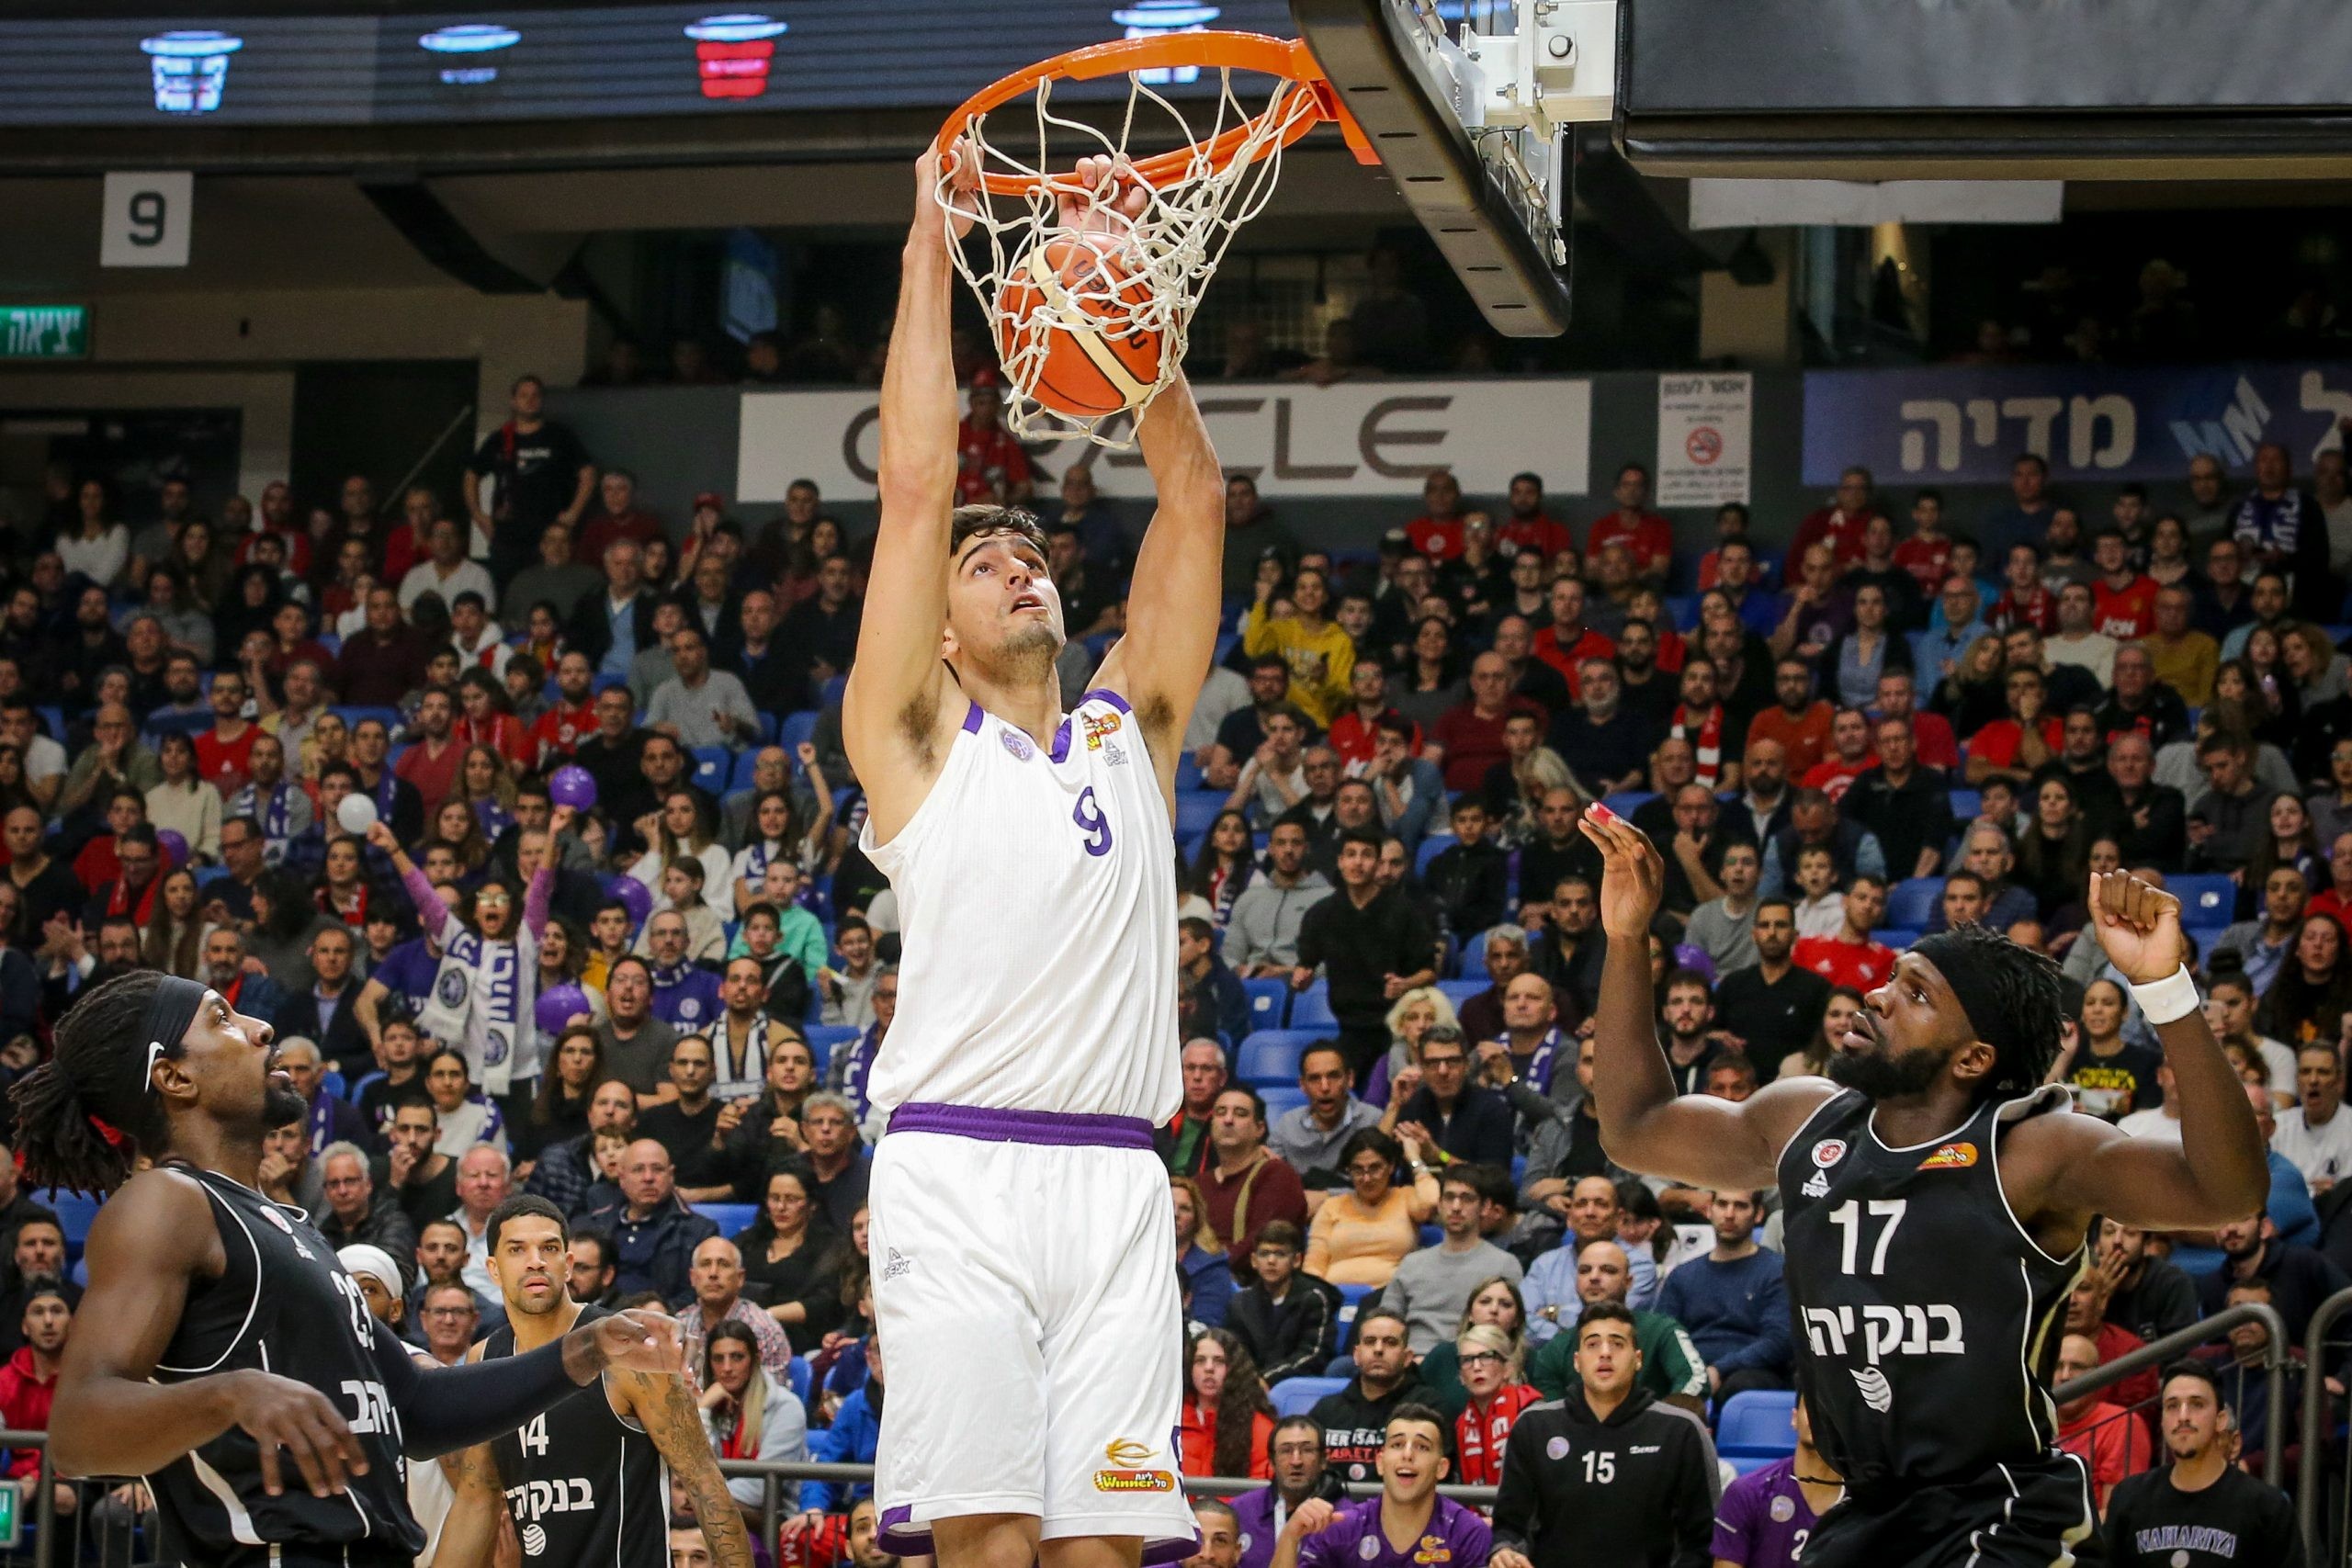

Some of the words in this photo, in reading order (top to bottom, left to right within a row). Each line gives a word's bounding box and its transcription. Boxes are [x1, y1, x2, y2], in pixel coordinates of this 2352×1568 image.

[129, 191, 166, 247] 9
[7, 310, 82, 355] יציאה
[1900, 394, 2137, 471] מדיה
[1073, 786, 1113, 856] 9
[1829, 1199, 1907, 1275] 17
[1801, 1304, 1855, 1357] יה
[1863, 1304, 1965, 1365] בנק
[1102, 1476, 1155, 1488] Winner
[1581, 1450, 1616, 1484] 15
[529, 1477, 595, 1521] בנק
[2135, 1525, 2237, 1559] NAHARIYA
